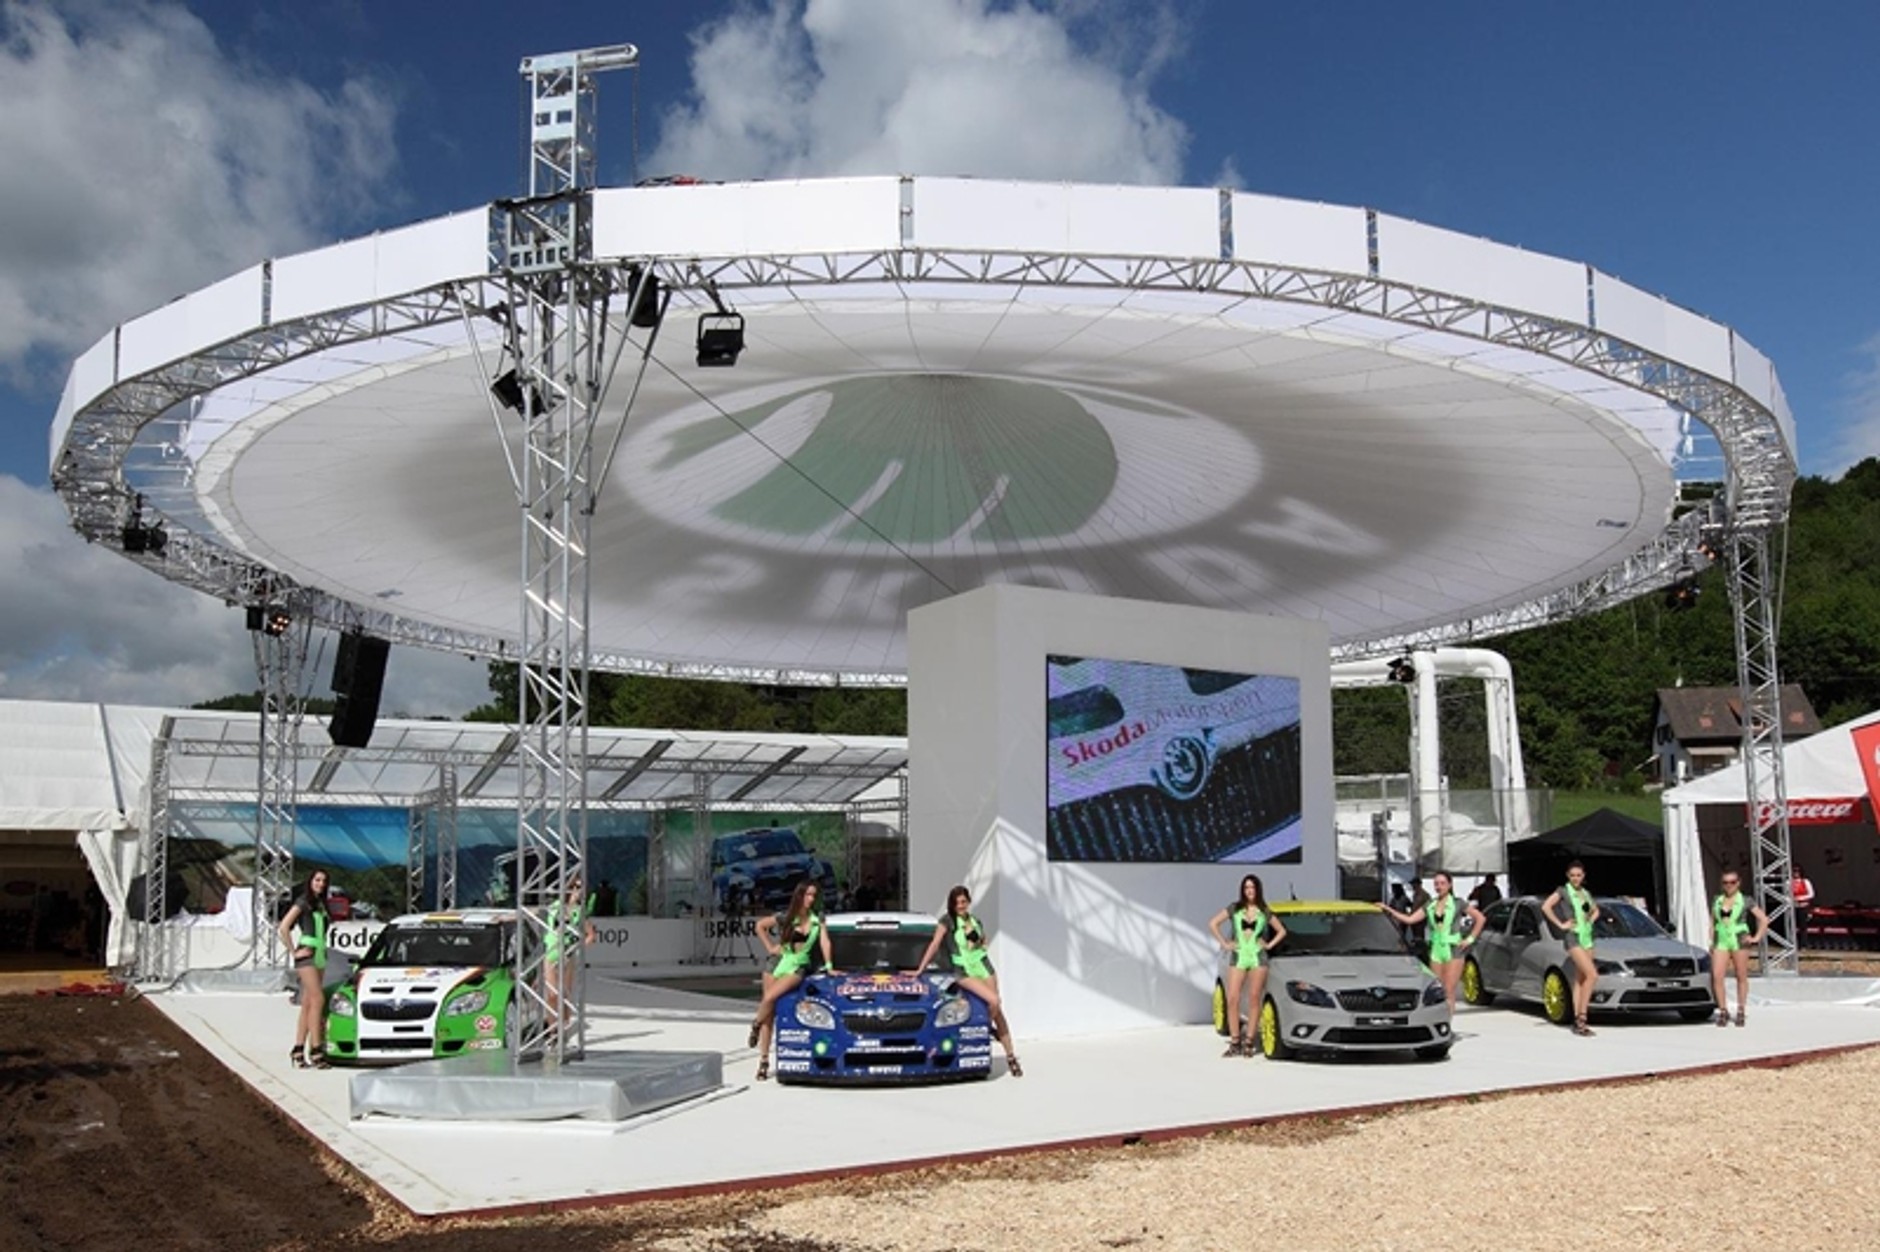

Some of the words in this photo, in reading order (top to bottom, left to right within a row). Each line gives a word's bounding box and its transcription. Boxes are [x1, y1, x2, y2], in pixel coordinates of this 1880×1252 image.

[1062, 721, 1146, 768] Skoda
[1758, 803, 1853, 824] Crrera
[592, 925, 629, 948] hop
